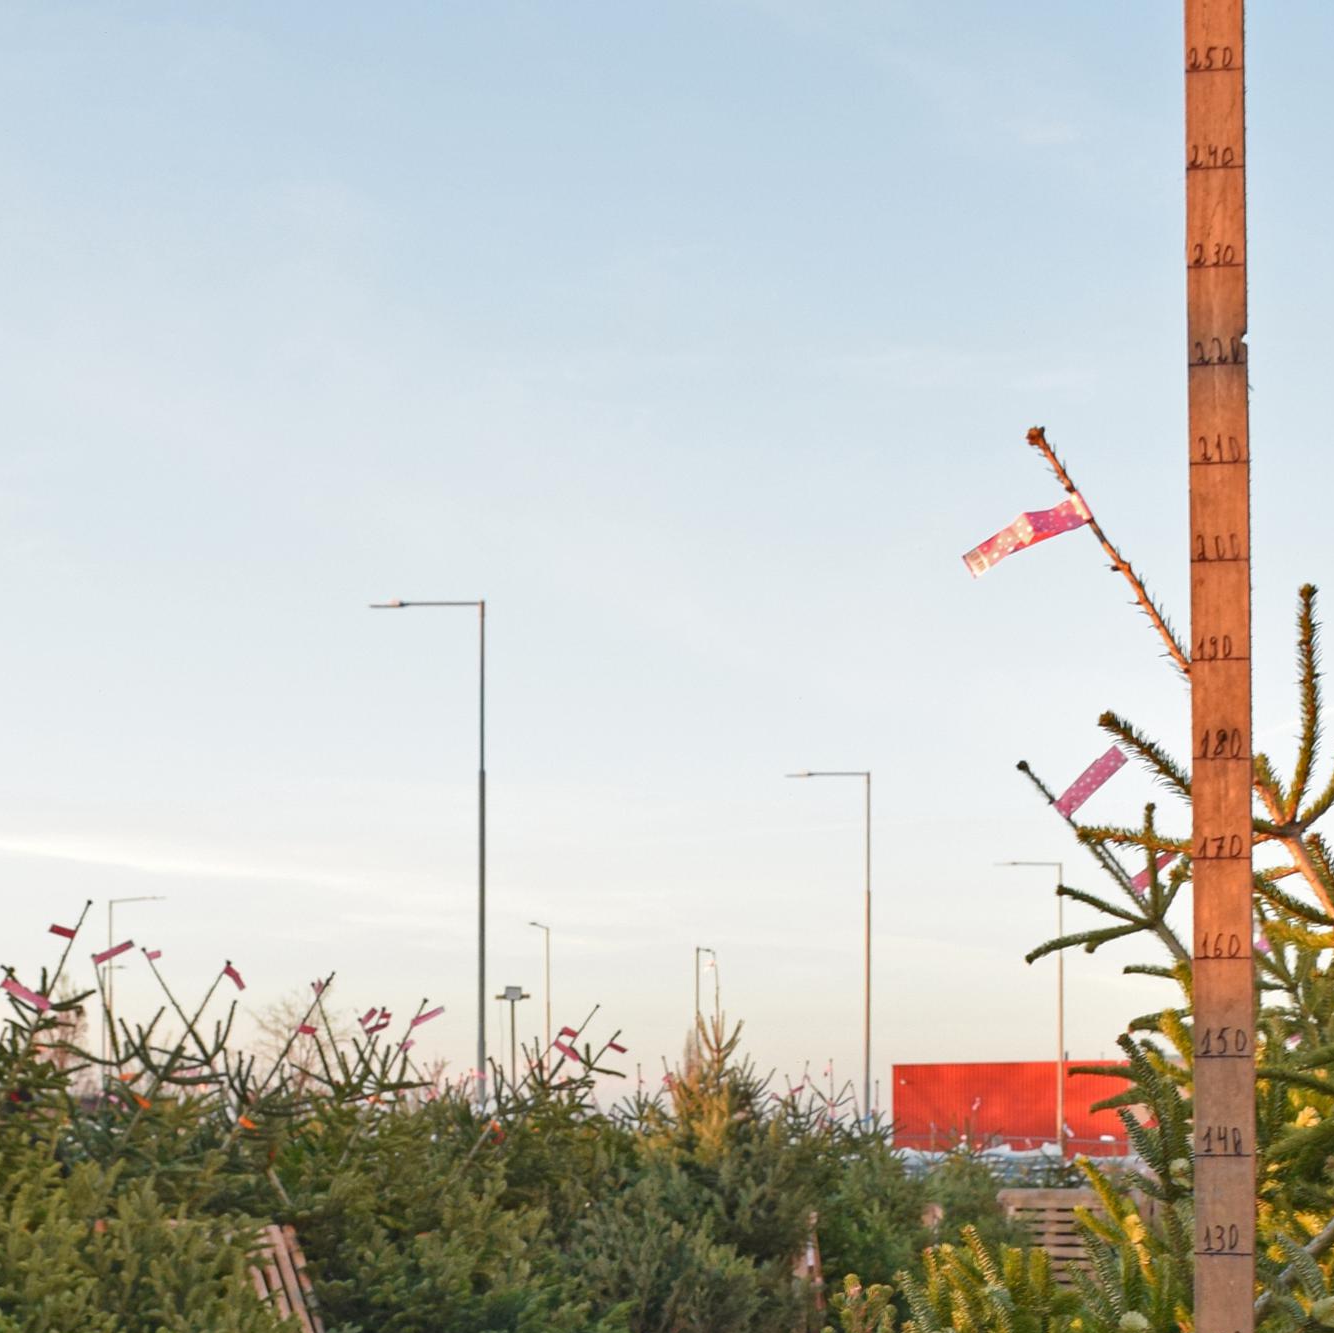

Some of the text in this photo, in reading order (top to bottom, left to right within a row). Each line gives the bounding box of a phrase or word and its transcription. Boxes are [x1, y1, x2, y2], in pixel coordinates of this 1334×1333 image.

[1188, 46, 1233, 69] 250
[1190, 144, 1235, 167] 240
[1193, 243, 1235, 266] 230
[1194, 336, 1241, 363] 220
[1198, 434, 1242, 462] 210
[1196, 532, 1239, 560] 200
[1198, 634, 1233, 661] 190
[1200, 727, 1242, 757] 180
[1198, 834, 1243, 857] 170
[1202, 932, 1241, 958] 160
[1200, 1026, 1248, 1055] 150
[1202, 1126, 1243, 1153] 140
[1203, 1223, 1239, 1251] 130
